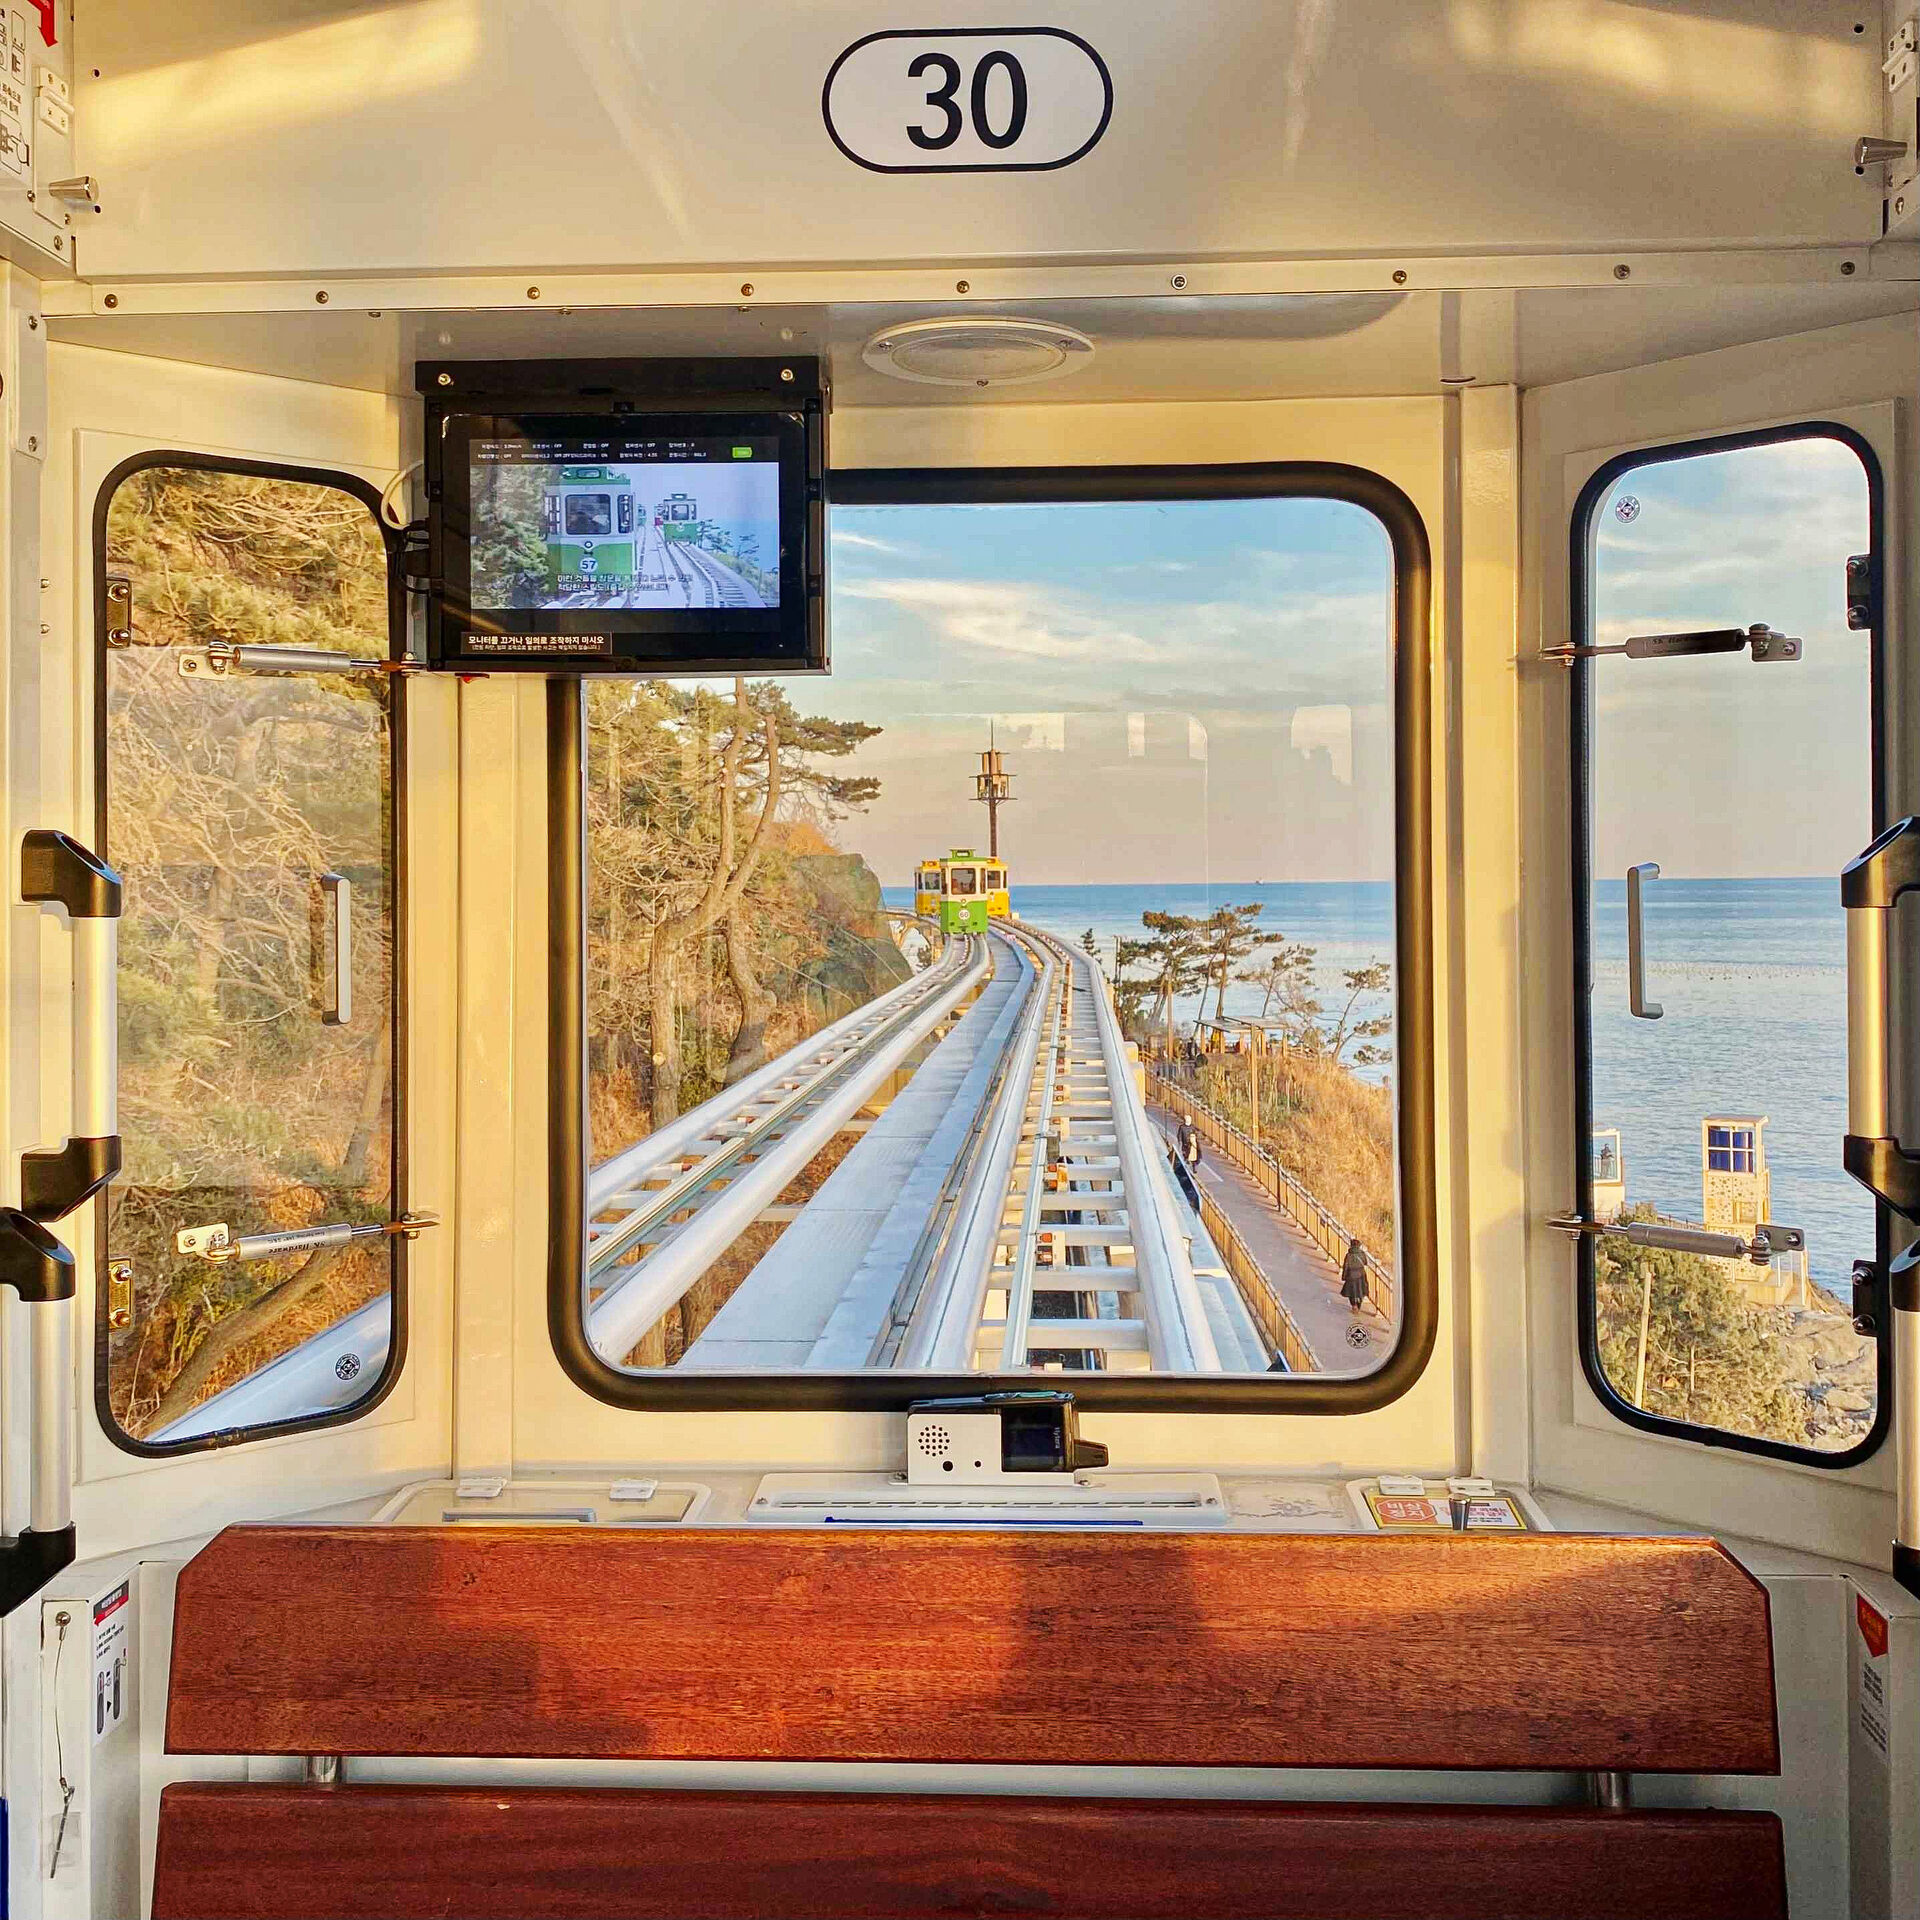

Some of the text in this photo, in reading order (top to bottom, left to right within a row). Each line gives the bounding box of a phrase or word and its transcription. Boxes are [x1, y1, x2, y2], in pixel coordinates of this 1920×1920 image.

[905, 50, 1028, 151] 30
[581, 560, 596, 570] 57
[468, 635, 498, 645] 모니터를
[525, 635, 547, 645] 임의로
[550, 635, 580, 645] 조작하지
[581, 635, 605, 645] 마시오
